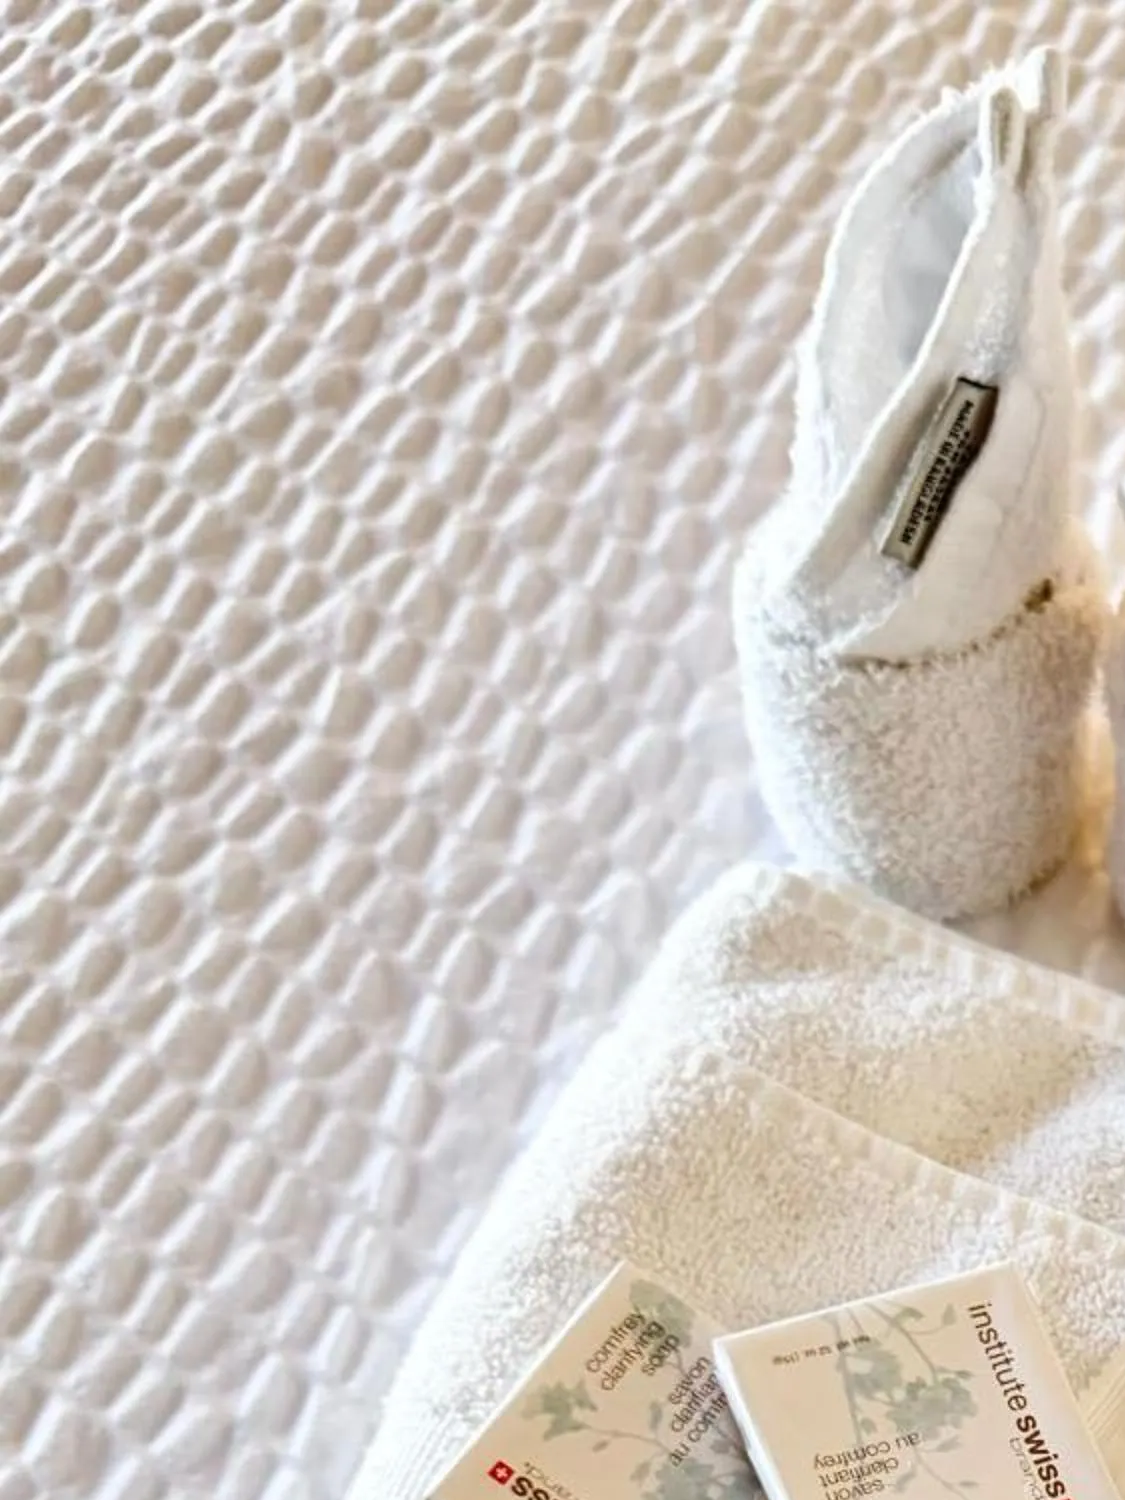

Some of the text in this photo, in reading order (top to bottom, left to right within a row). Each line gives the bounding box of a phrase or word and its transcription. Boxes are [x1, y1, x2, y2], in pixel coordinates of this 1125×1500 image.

[586, 1307, 647, 1373] comfrey
[601, 1320, 666, 1391] clarifying
[641, 1334, 680, 1377] soap
[668, 1356, 711, 1405] savon
[671, 1373, 720, 1433] clarifian
[968, 1300, 1066, 1500] institute swiss
[669, 1391, 728, 1467] au comfr
[814, 1431, 920, 1470] au comfrey
[818, 1457, 899, 1488] clarifiant
